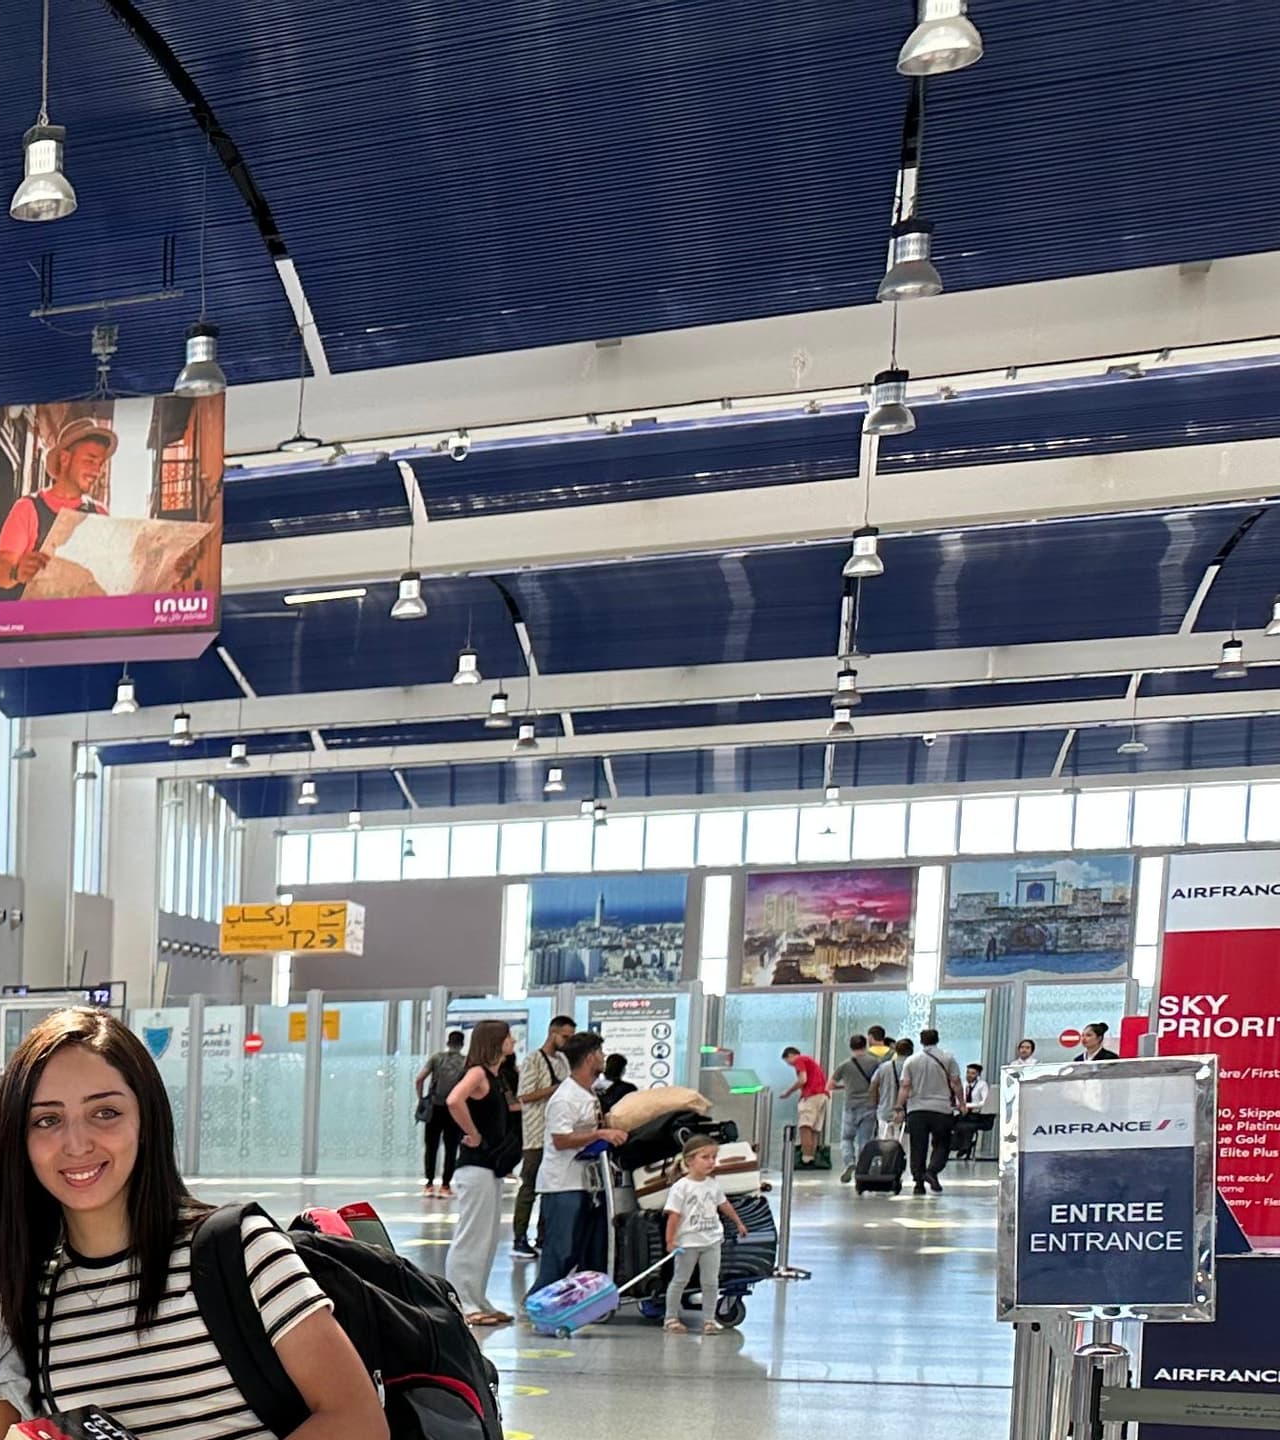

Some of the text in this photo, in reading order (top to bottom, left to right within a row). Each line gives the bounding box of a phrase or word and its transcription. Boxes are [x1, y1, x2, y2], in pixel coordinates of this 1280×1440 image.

[226, 906, 291, 926] إركاب
[288, 930, 316, 949] T2
[1158, 994, 1229, 1016] SKY
[1158, 1016, 1280, 1039] PRIORI
[1032, 1120, 1152, 1136] AIRFRANCE
[1235, 1134, 1267, 1145] Gold
[1220, 1147, 1279, 1158] Elite Plus
[1051, 1202, 1164, 1224] ENTREE
[1030, 1231, 1183, 1252] ENTRANCE
[1154, 1368, 1280, 1383] AIRFRANC
